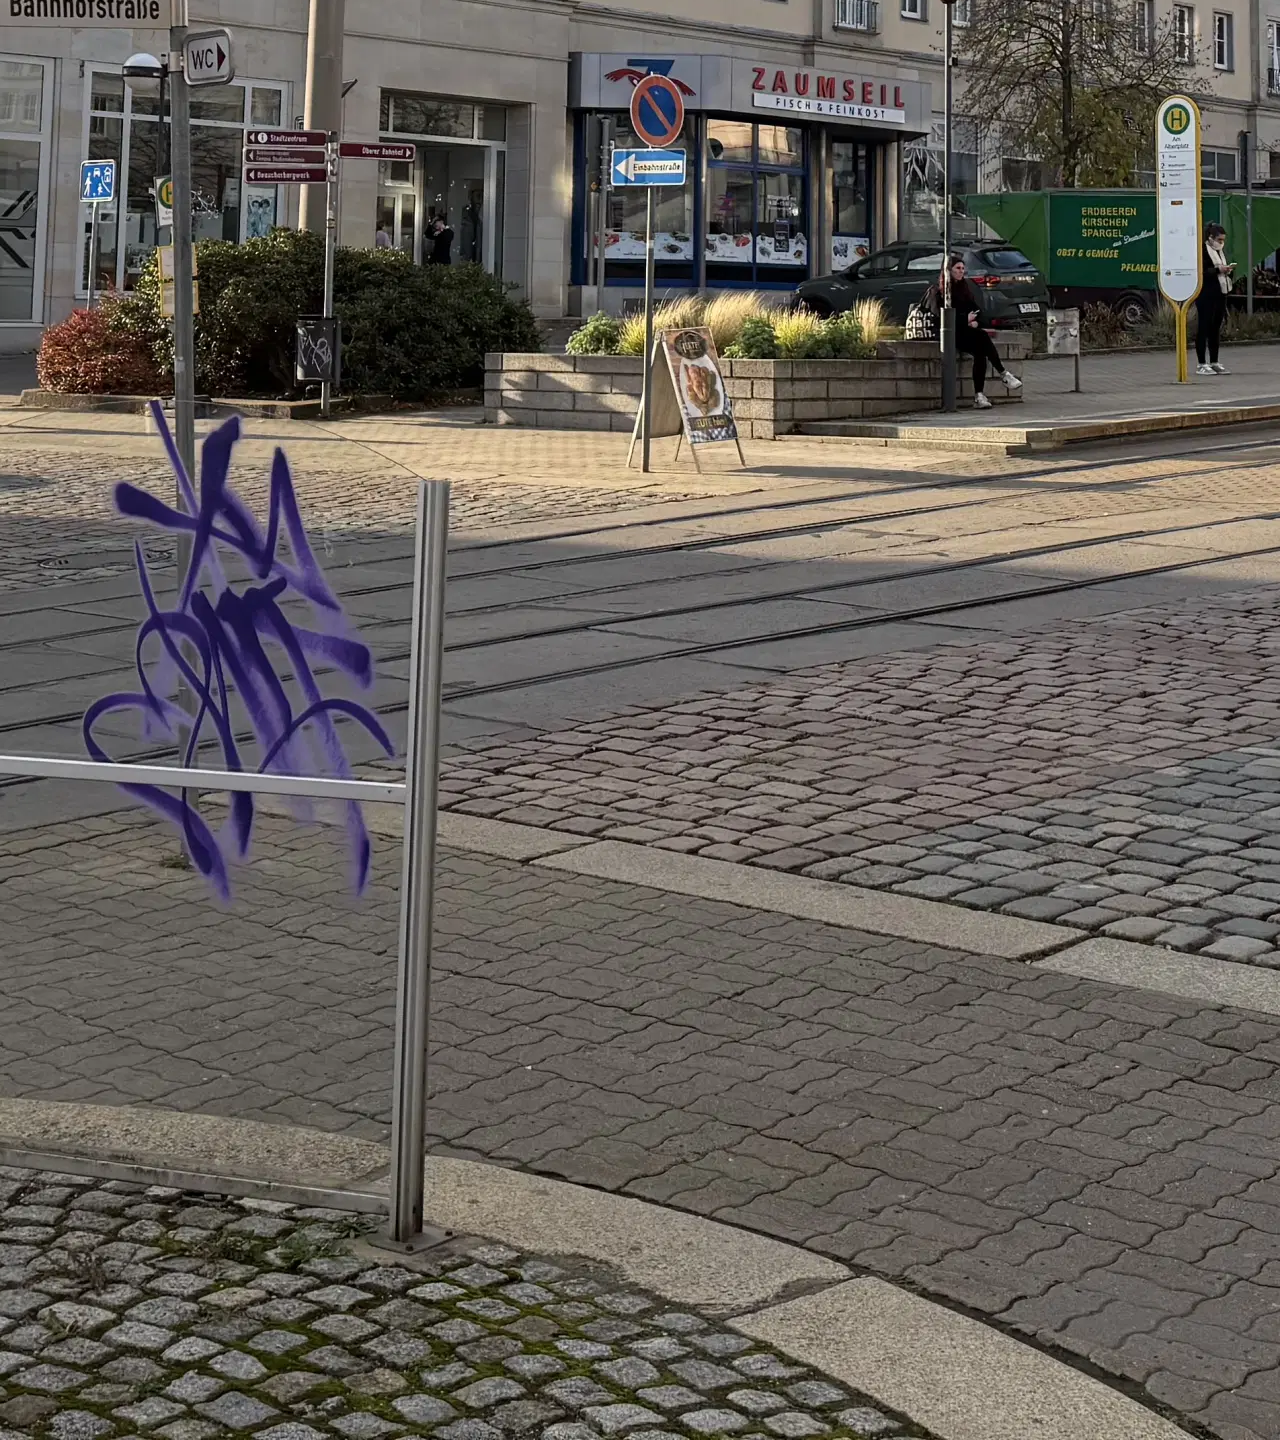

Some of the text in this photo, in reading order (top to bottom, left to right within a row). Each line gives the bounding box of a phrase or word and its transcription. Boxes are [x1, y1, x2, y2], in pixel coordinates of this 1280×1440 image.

[191, 48, 214, 71] WC
[751, 67, 905, 108] ZAUMSEIL
[775, 97, 886, 119] FISCH & FEINKOST
[633, 162, 681, 172] Einbahnstraße
[1081, 207, 1137, 216] ERDBEEREN
[1081, 218, 1128, 227] KIRSCHEN
[1081, 228, 1123, 238] SPARGEL
[1056, 248, 1076, 257] OBST
[1085, 248, 1119, 258] GEMÜSE
